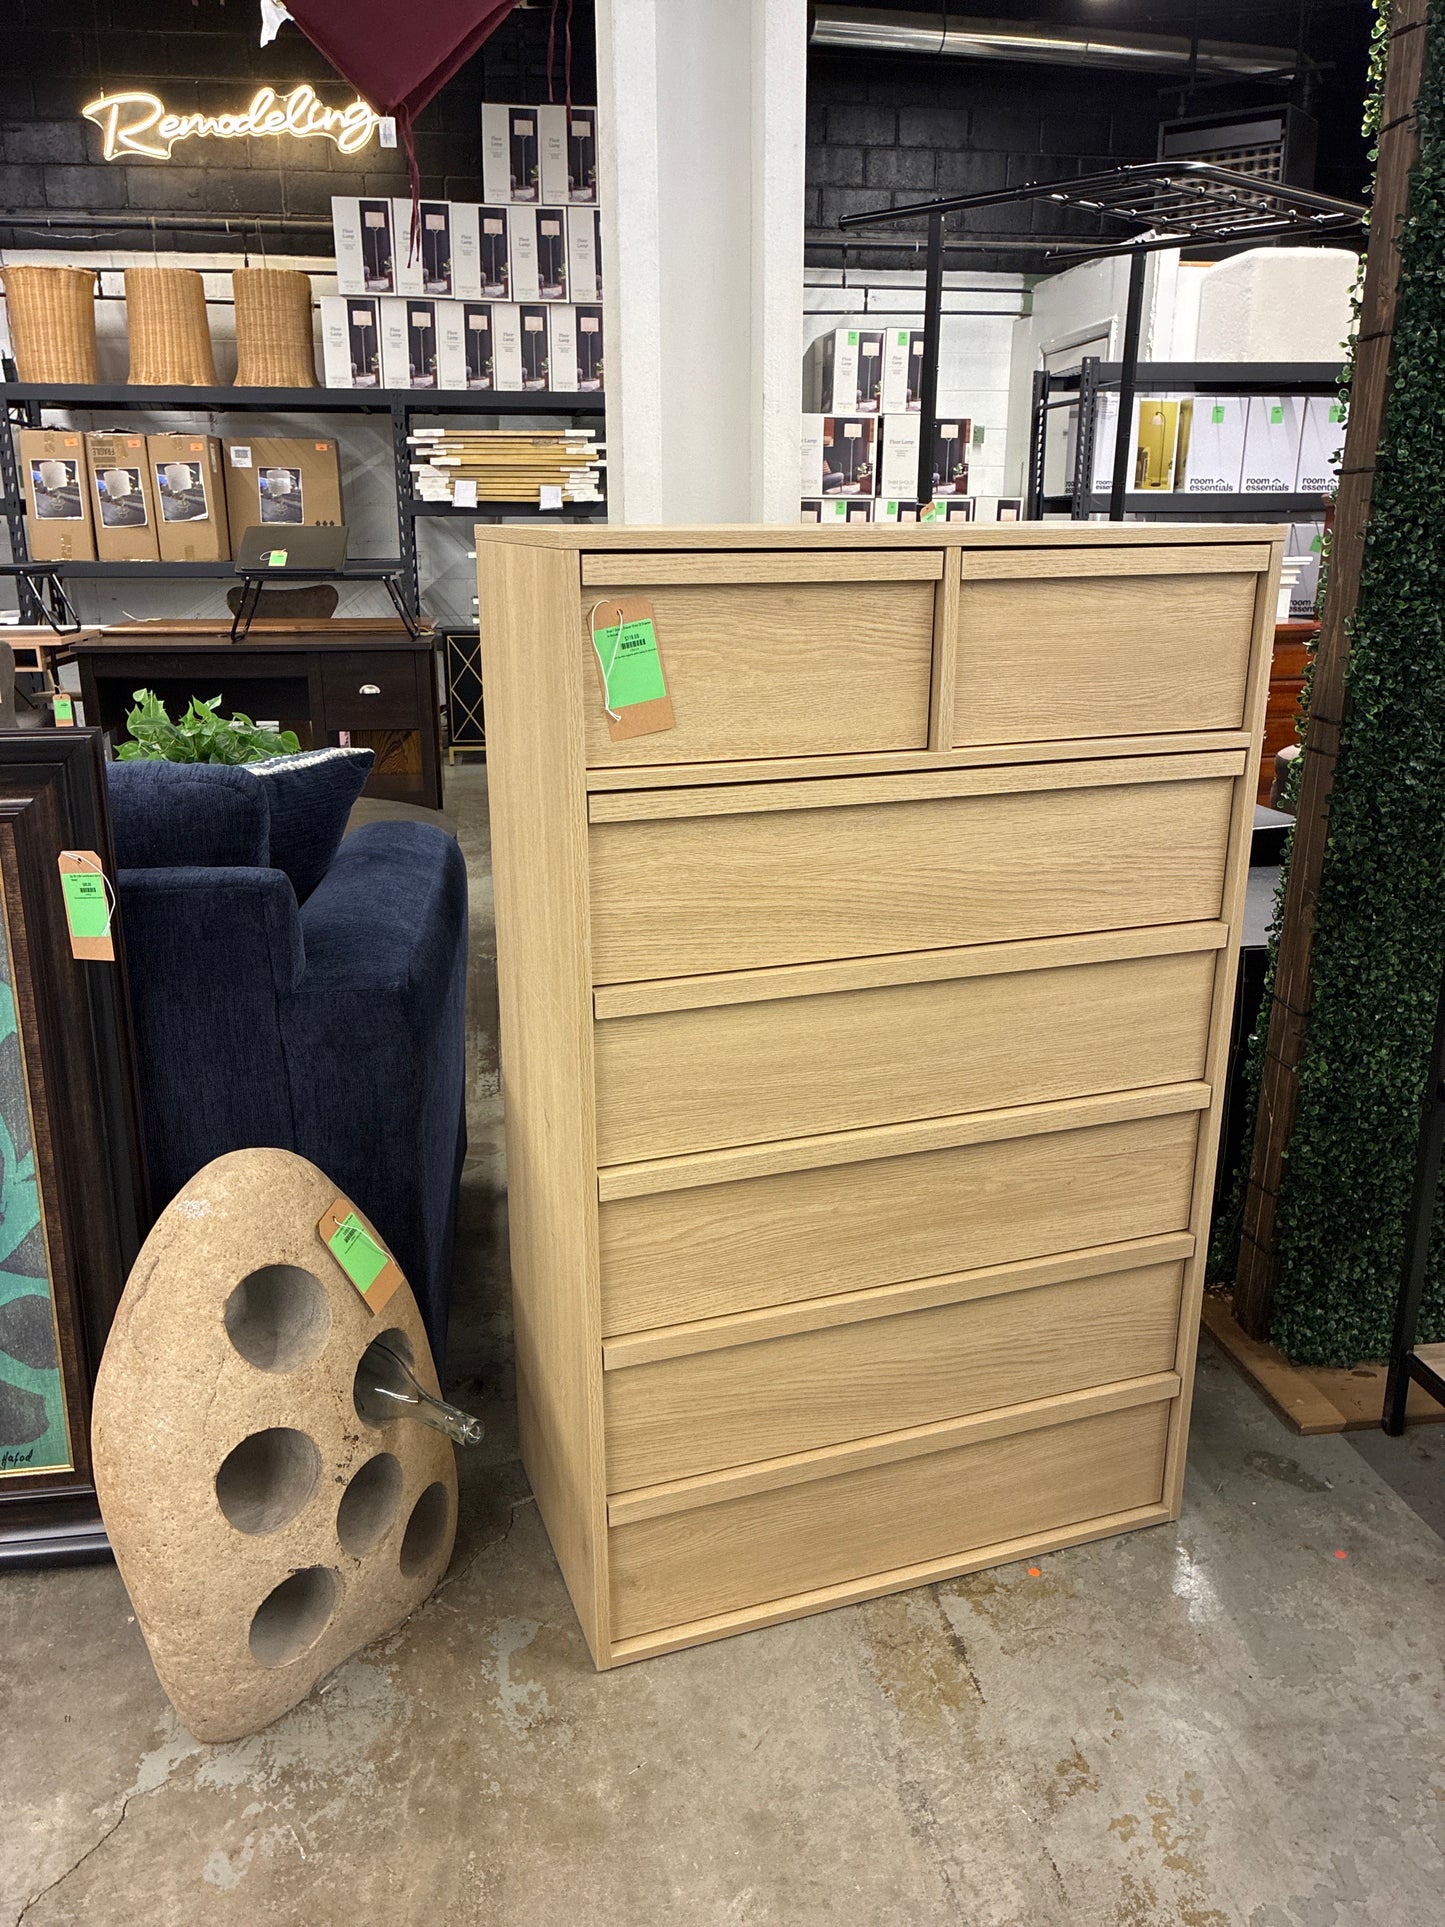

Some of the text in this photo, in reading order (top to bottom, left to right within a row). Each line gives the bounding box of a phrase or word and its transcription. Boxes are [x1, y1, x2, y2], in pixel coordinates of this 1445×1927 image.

[82, 84, 380, 158] Remodeling
[1190, 484, 1234, 492] essentials
[1246, 483, 1290, 492] essentials
